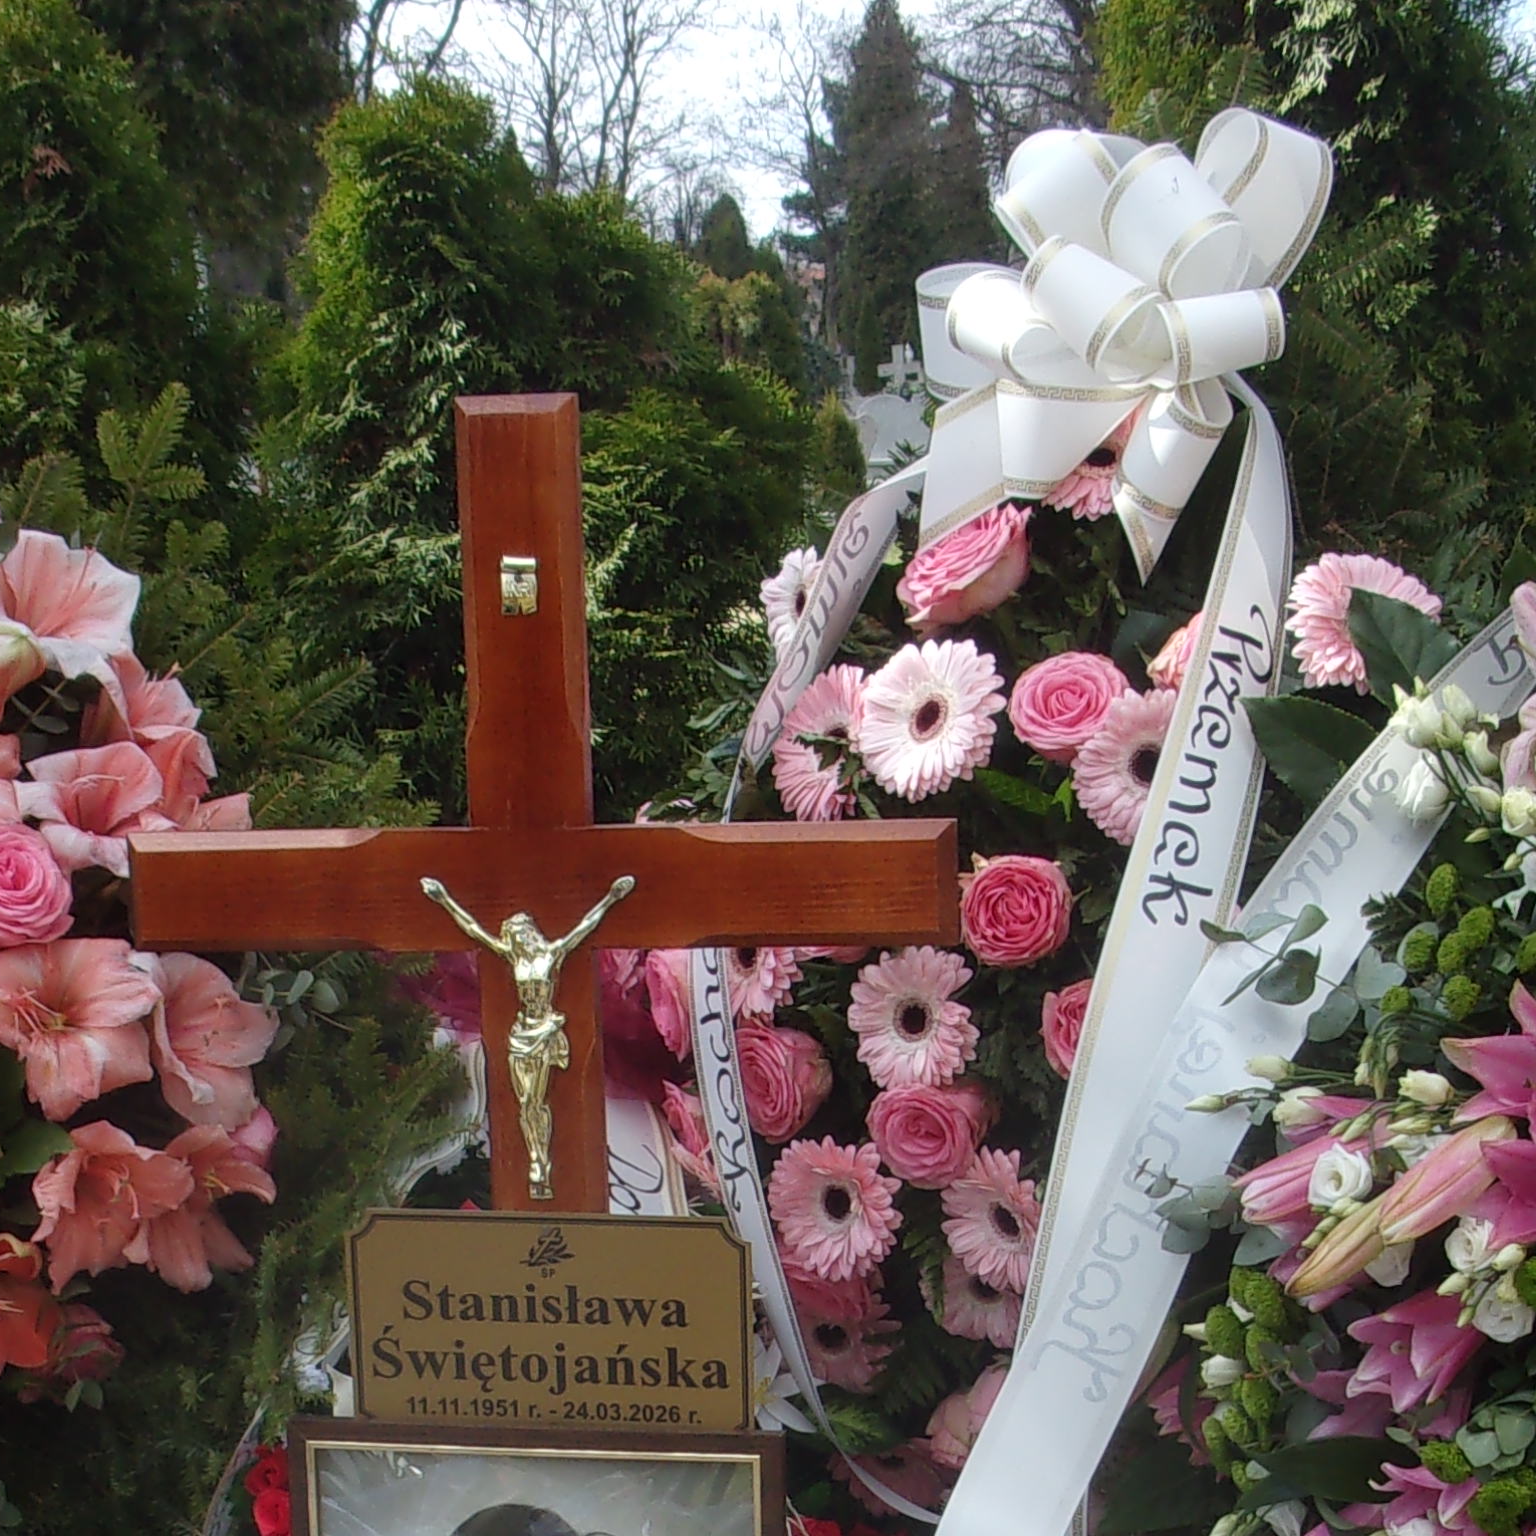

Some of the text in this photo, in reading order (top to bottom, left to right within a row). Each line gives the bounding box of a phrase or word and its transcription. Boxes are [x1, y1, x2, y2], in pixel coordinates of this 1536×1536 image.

[1145, 604, 1276, 928] Przemek
[402, 1279, 689, 1328] Stanisława
[372, 1325, 730, 1395] Świętojańska
[406, 1396, 519, 1419] 11.11.1951
[528, 1402, 542, 1419] r.
[563, 1400, 680, 1424] 24.03.2026
[688, 1408, 702, 1425] r.
